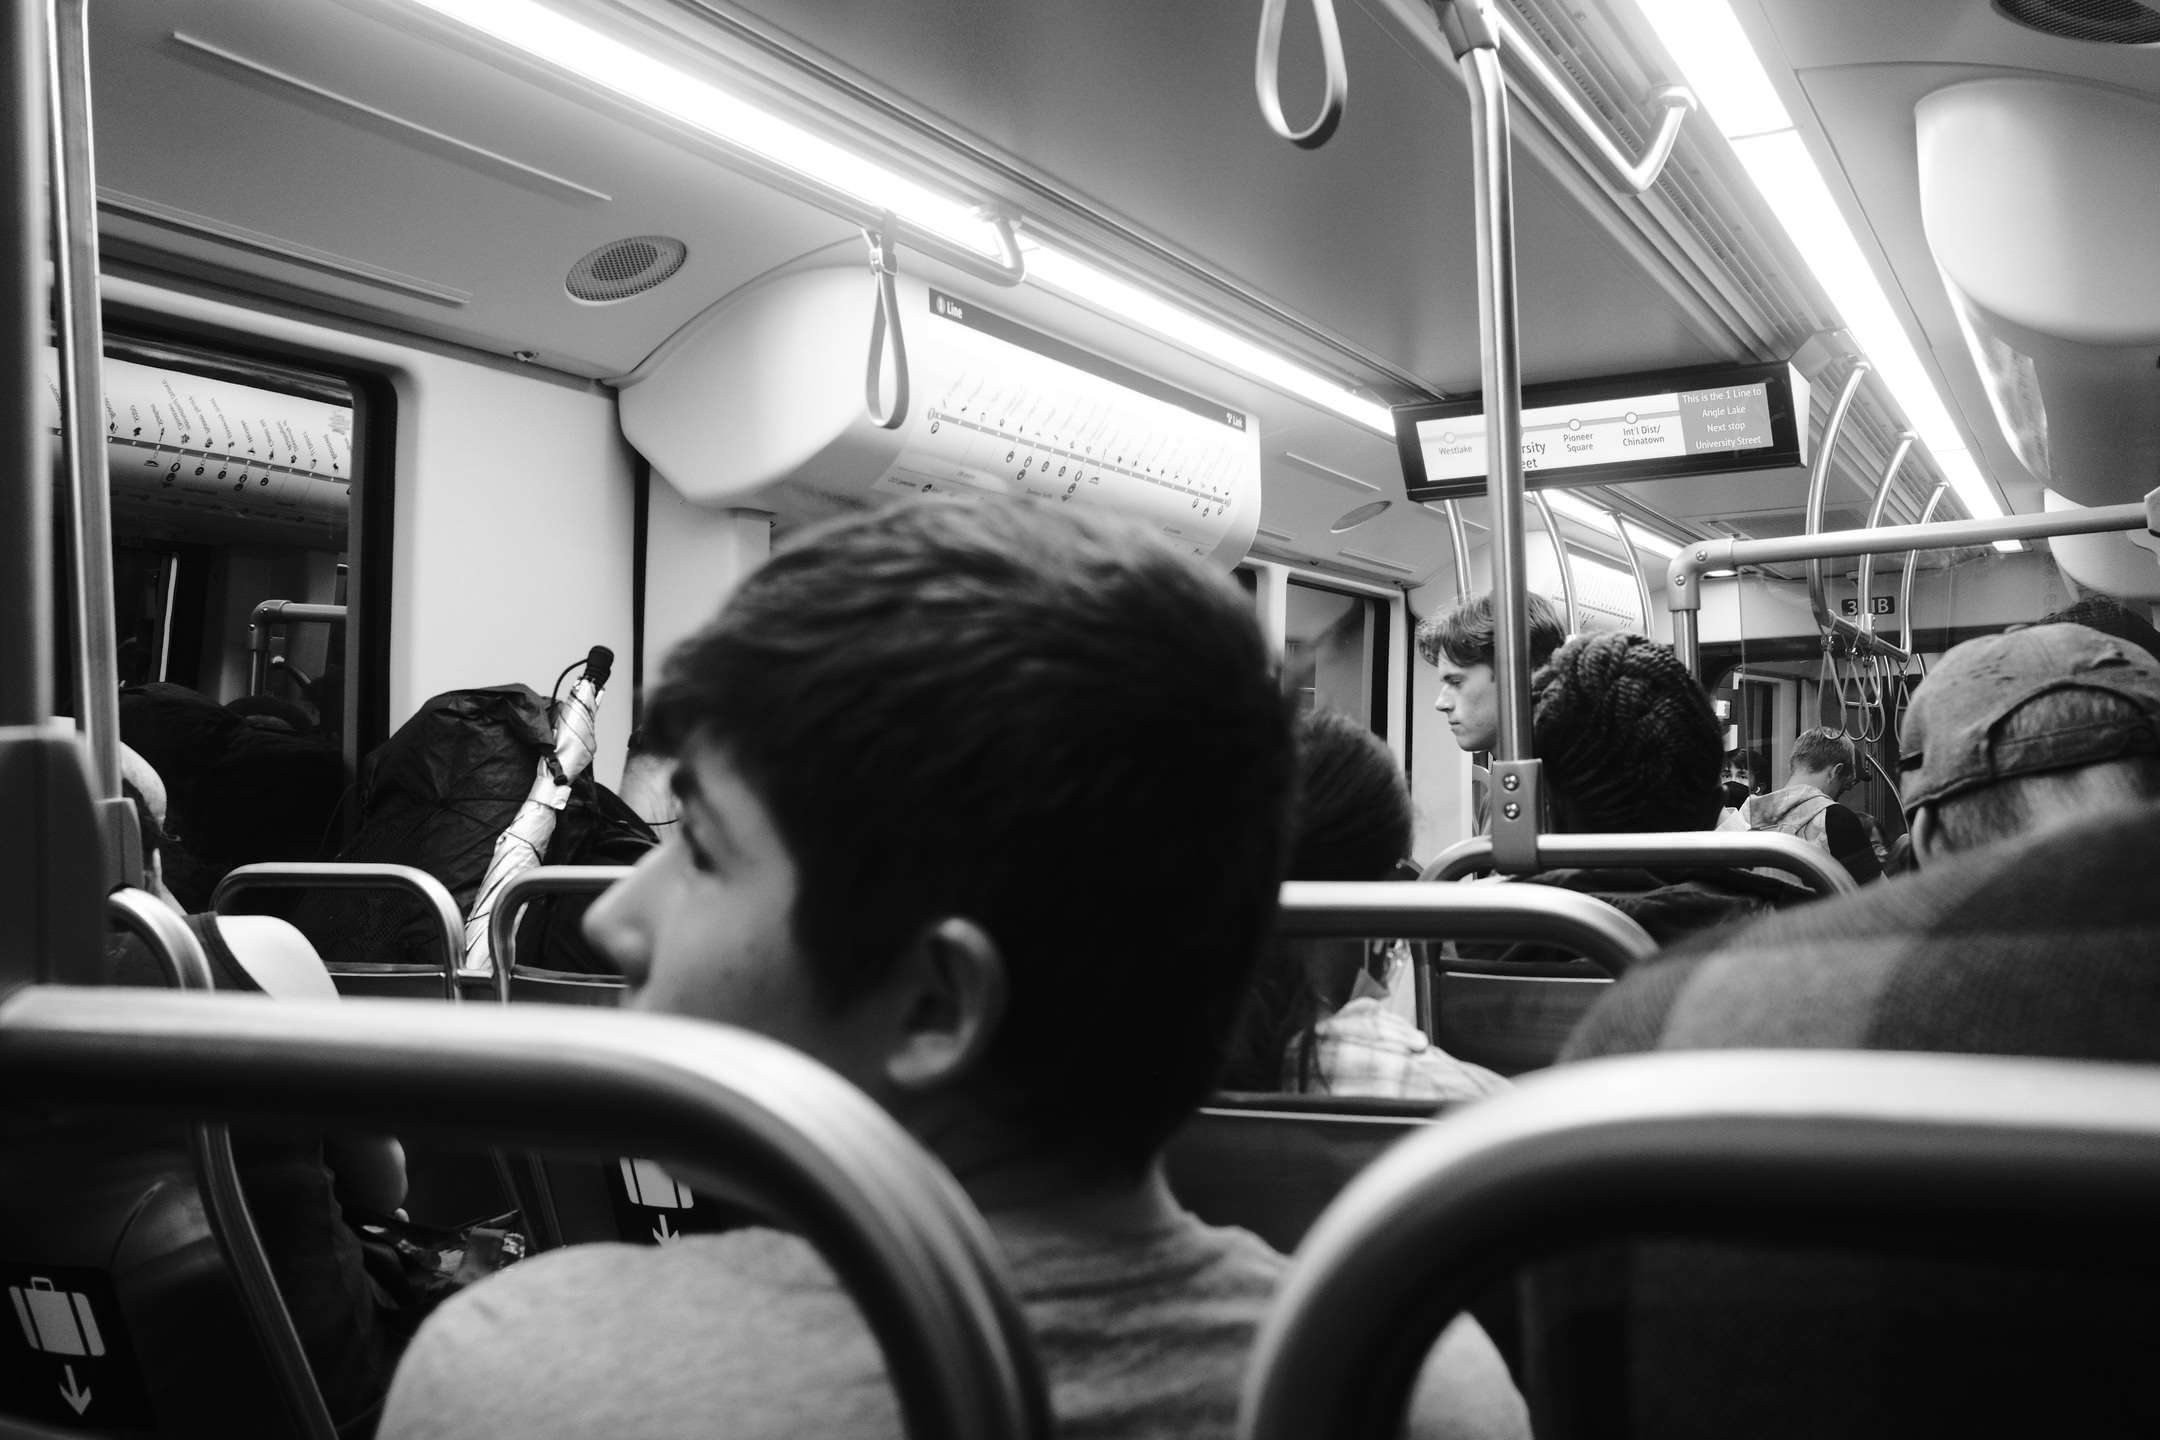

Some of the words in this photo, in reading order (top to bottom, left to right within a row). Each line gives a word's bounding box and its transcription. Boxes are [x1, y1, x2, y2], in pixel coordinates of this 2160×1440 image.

[946, 300, 963, 320] Line
[1682, 394, 1699, 404] This
[1701, 393, 1708, 402] is
[1710, 392, 1723, 401] the
[1726, 391, 1730, 399] 1
[1733, 389, 1751, 398] Line
[1702, 408, 1725, 418] Angle
[1727, 406, 1746, 415] Lake
[1623, 428, 1639, 436] Int'l
[1641, 425, 1660, 434] Dist/
[1707, 424, 1726, 432] Next
[1728, 422, 1745, 431] stop
[1564, 433, 1593, 442] Pioneer
[1623, 436, 1665, 446] Chinatown
[1695, 438, 1735, 449] University
[1737, 436, 1761, 445] Street
[1438, 446, 1472, 455] Westlake
[1566, 442, 1594, 453] Square
